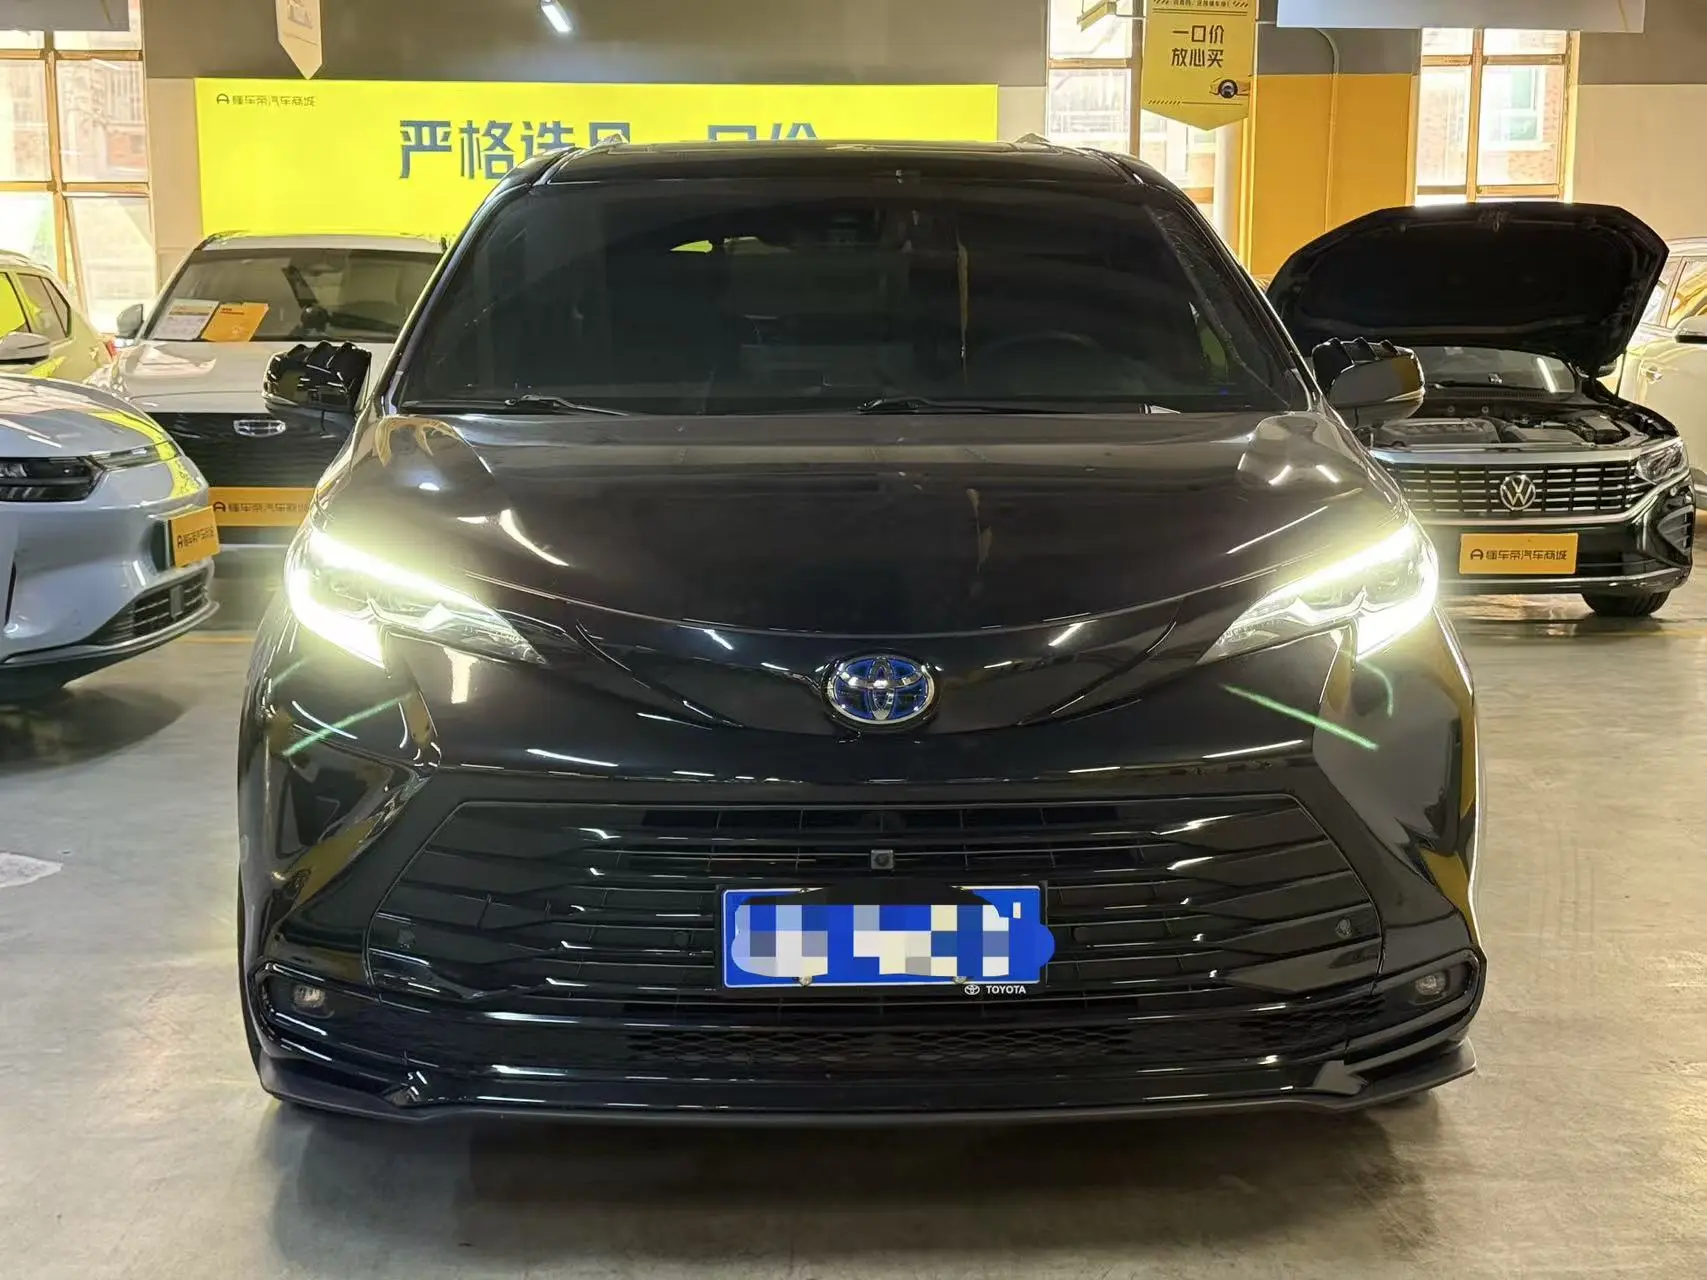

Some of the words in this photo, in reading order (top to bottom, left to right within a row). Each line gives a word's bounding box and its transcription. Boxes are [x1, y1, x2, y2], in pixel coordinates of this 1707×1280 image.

[1172, 25, 1224, 44] 一口价
[1171, 48, 1224, 68] 放心买
[986, 985, 1027, 994] TOYOTA
